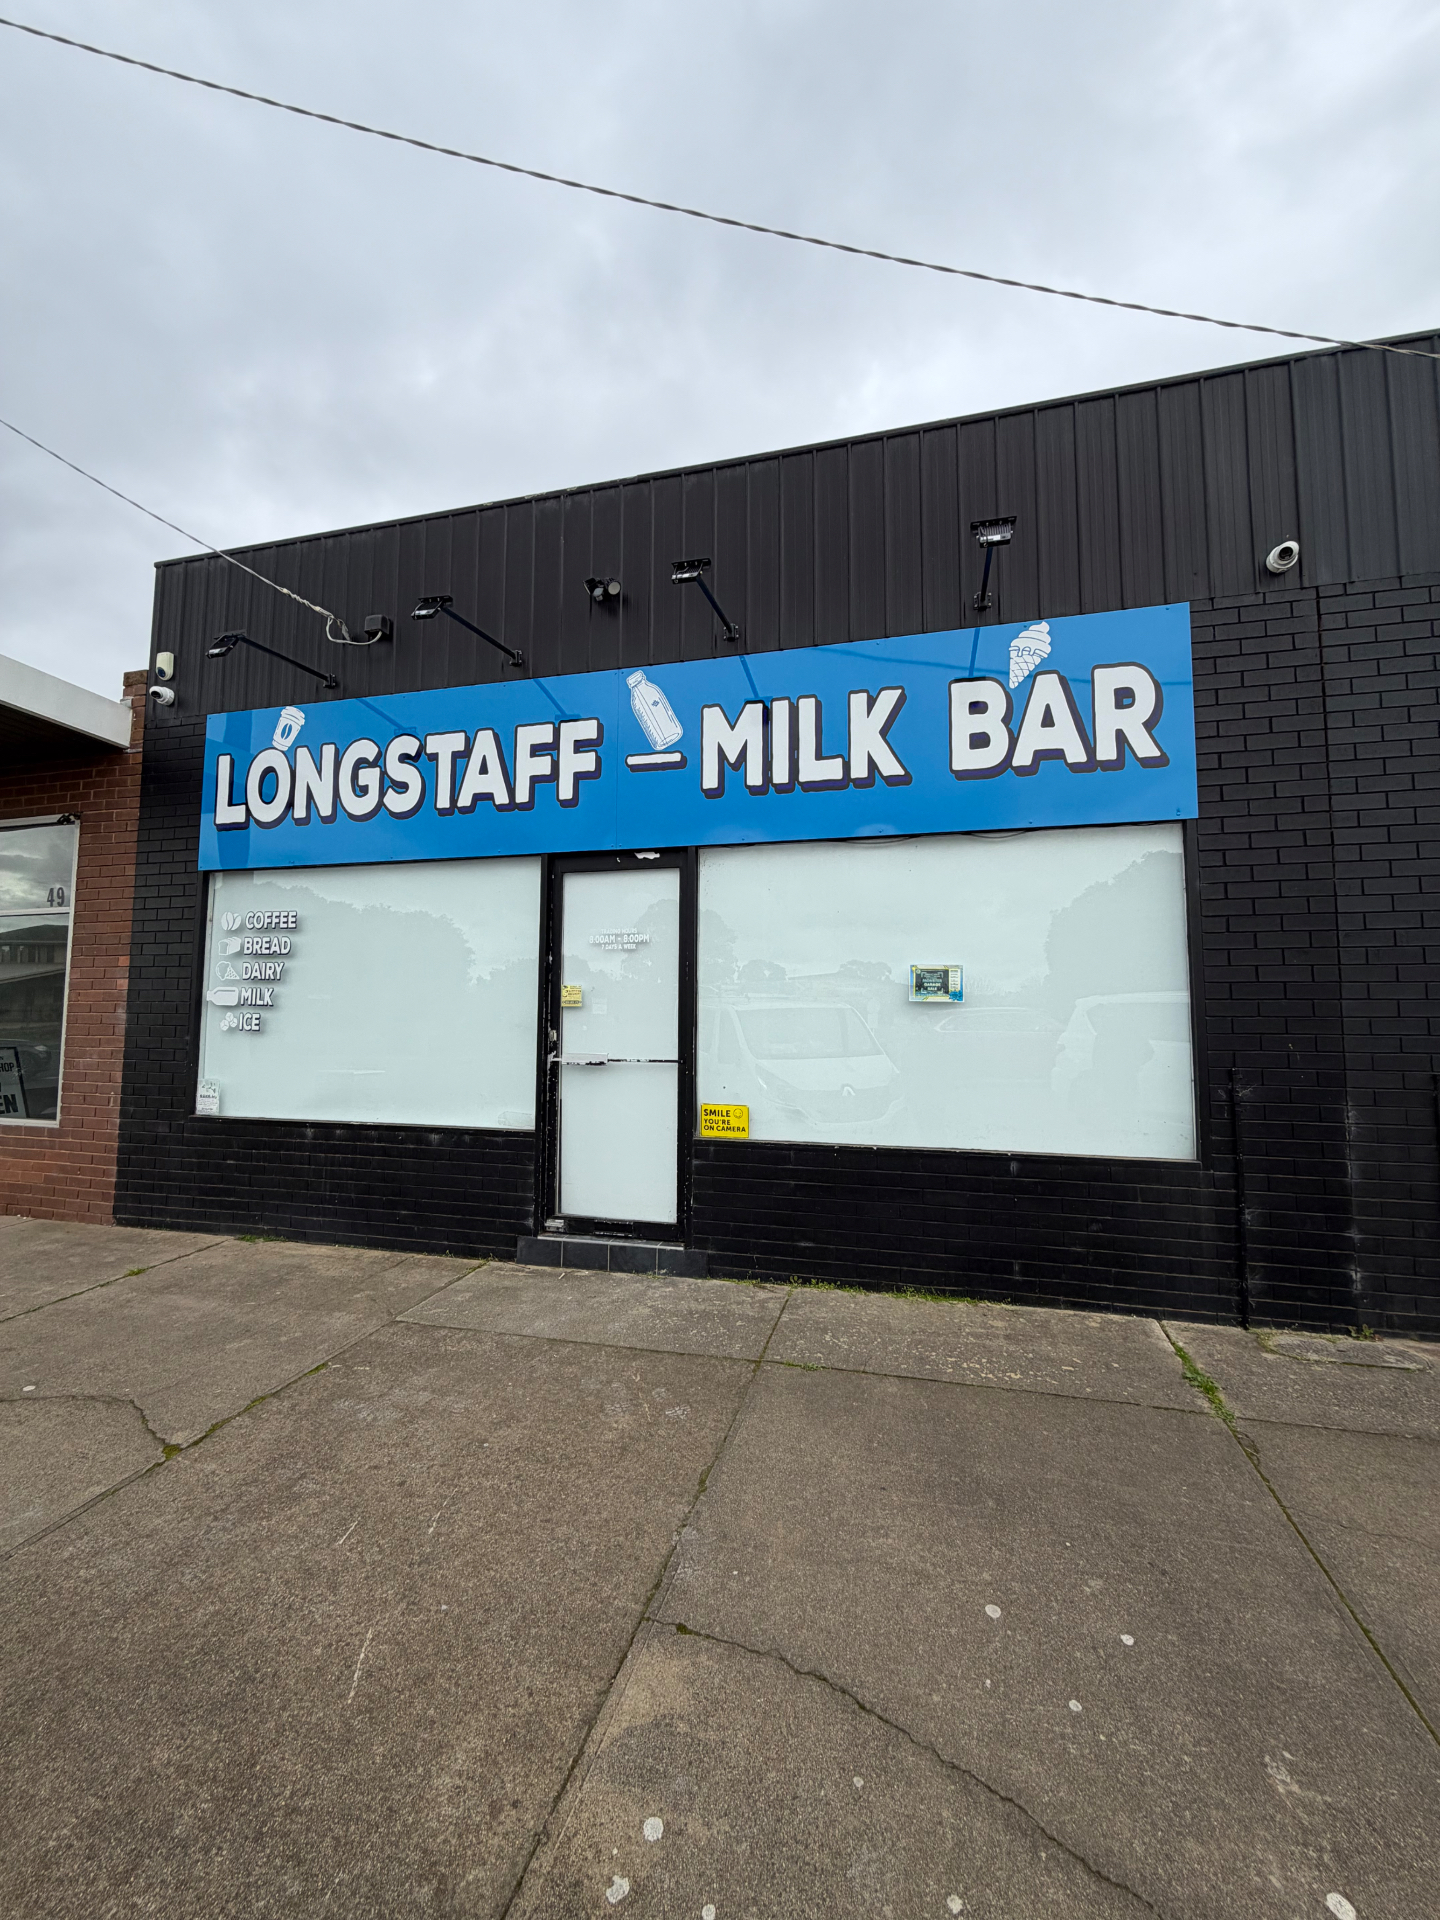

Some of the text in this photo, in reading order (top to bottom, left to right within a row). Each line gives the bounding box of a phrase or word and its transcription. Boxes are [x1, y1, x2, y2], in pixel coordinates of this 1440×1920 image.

[214, 718, 604, 831] LONGSTAFF
[701, 686, 912, 799] MILK
[948, 661, 1170, 781] BAR
[46, 886, 65, 907] 49
[245, 910, 298, 930] COFFEE
[243, 935, 292, 955] BREAD
[242, 961, 285, 981] DAIRY
[240, 986, 274, 1006] MILK
[239, 1011, 261, 1031] ICE
[0, 1062, 14, 1072] HOP
[703, 1109, 731, 1117] SMILE
